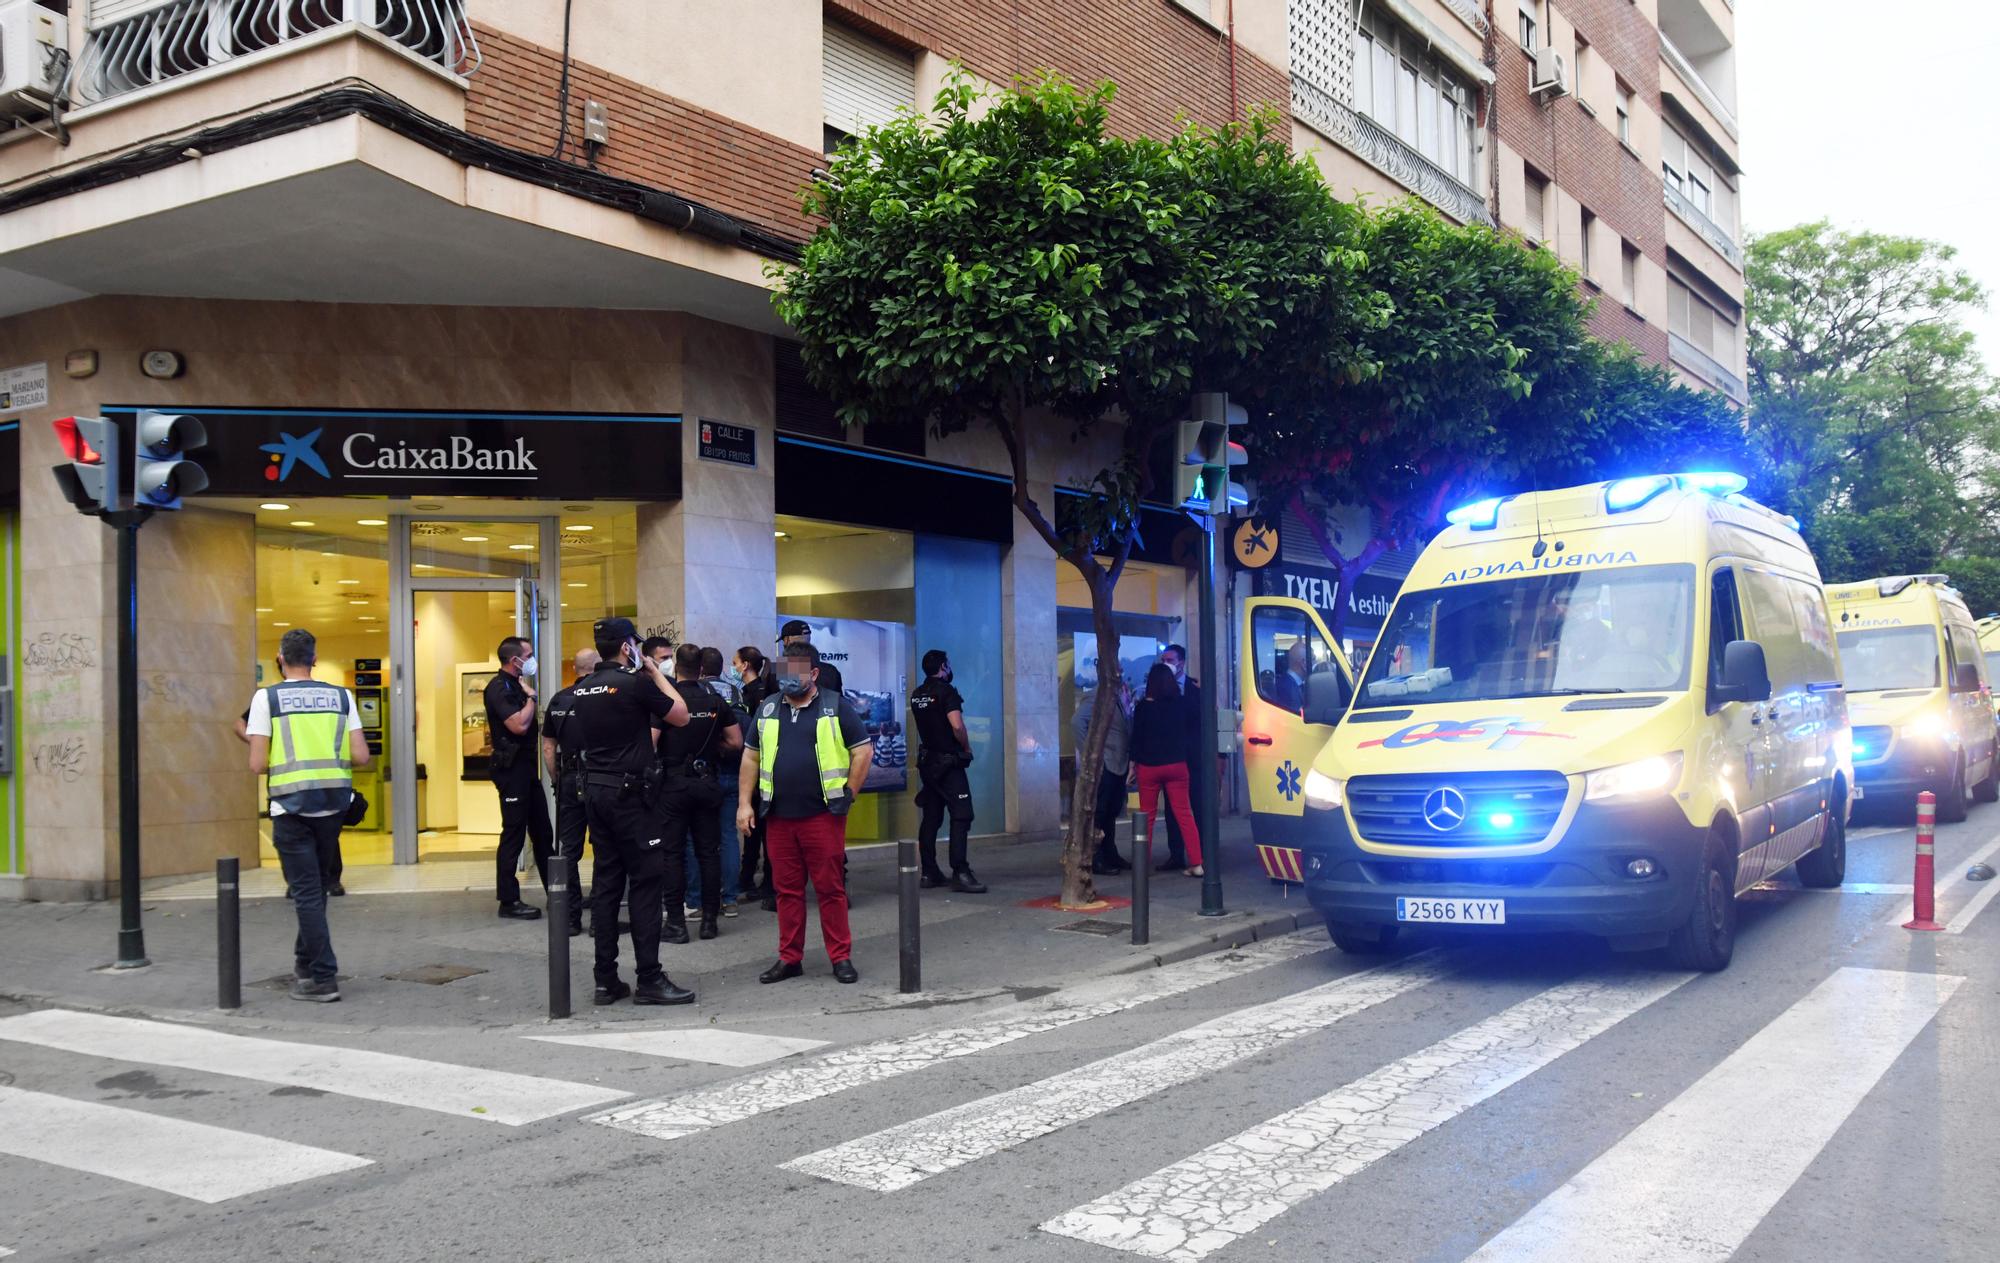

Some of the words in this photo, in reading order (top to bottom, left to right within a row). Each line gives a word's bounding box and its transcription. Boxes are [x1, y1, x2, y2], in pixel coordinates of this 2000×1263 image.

[717, 426, 744, 441] CALLE
[342, 432, 538, 470] CaixaBank
[281, 696, 339, 710] POLICIA
[1382, 716, 1548, 750] 061
[1410, 902, 1456, 919] 2566
[1463, 902, 1499, 920] KYY
